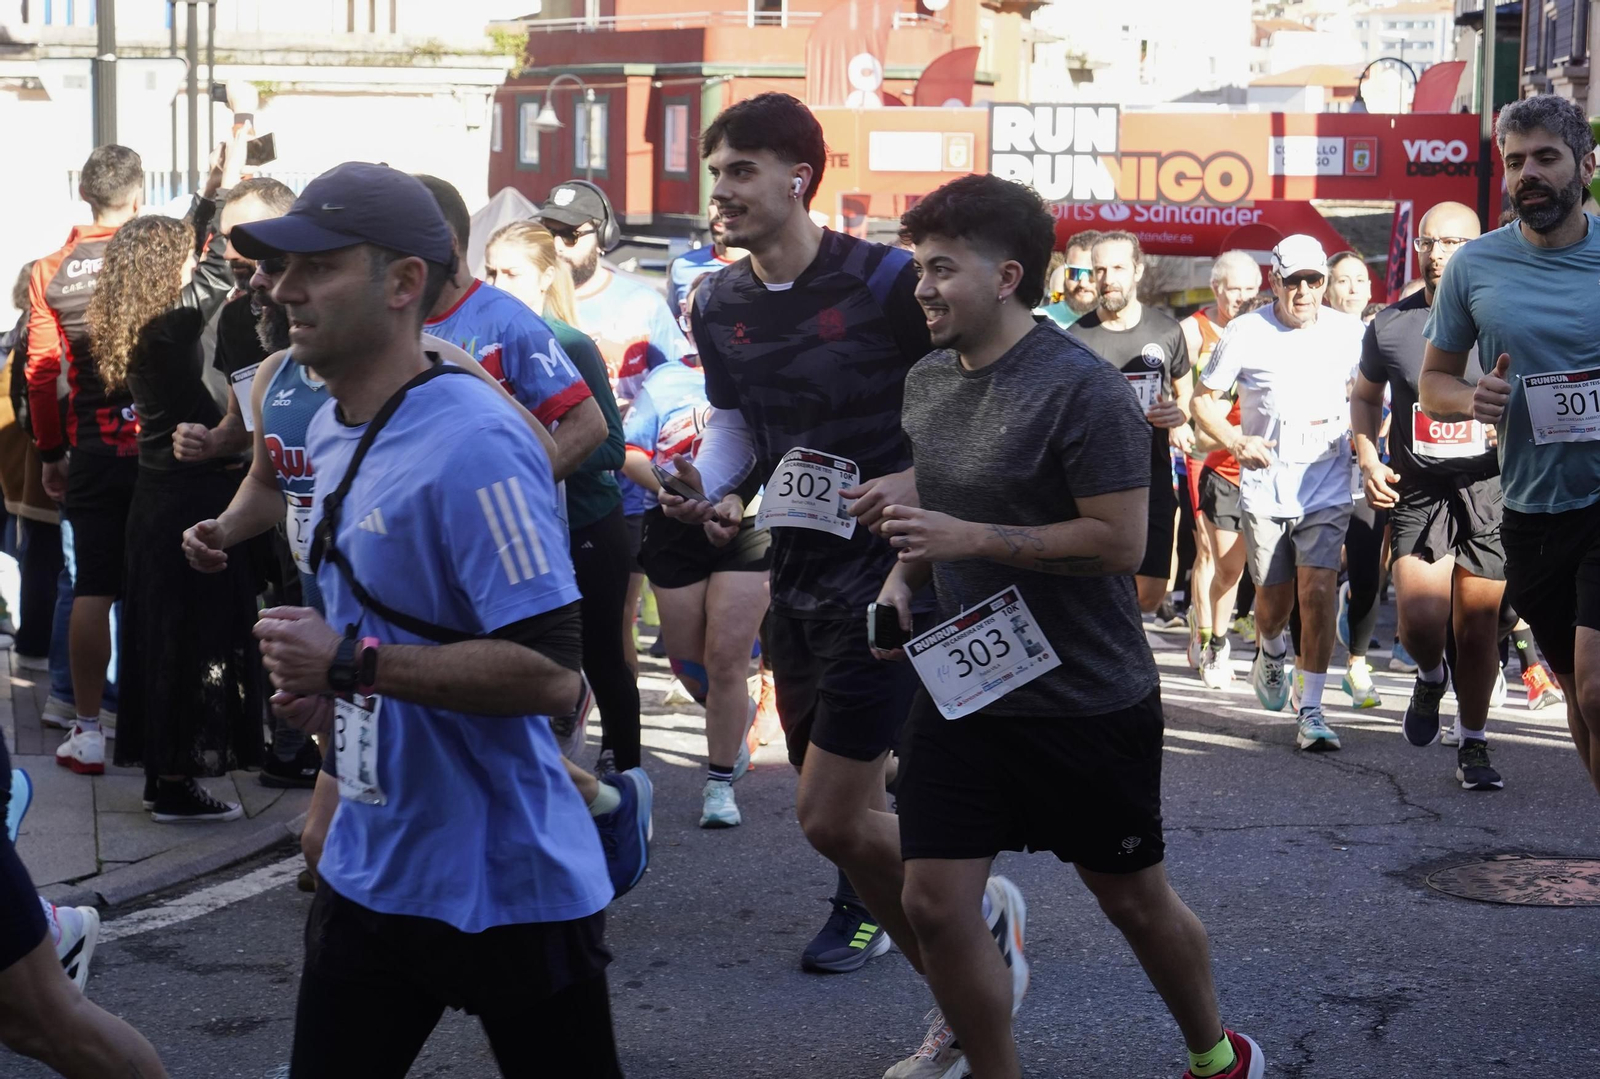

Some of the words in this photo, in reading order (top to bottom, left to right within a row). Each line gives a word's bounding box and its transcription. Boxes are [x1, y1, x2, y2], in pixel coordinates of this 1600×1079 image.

[992, 106, 1117, 153] RUN
[1402, 139, 1468, 163] VIGO
[1050, 203, 1096, 221] orts
[1134, 205, 1263, 226] Santander
[67, 257, 104, 279] CAR
[1554, 389, 1600, 416] 301
[1429, 421, 1467, 439] 602
[779, 471, 831, 503] 302
[839, 471, 854, 481] 10K
[1002, 603, 1020, 617] 10K
[949, 628, 977, 645] CARREIRA
[976, 624, 985, 632] DE
[984, 617, 996, 627] TEIS
[948, 629, 1011, 678] 303
